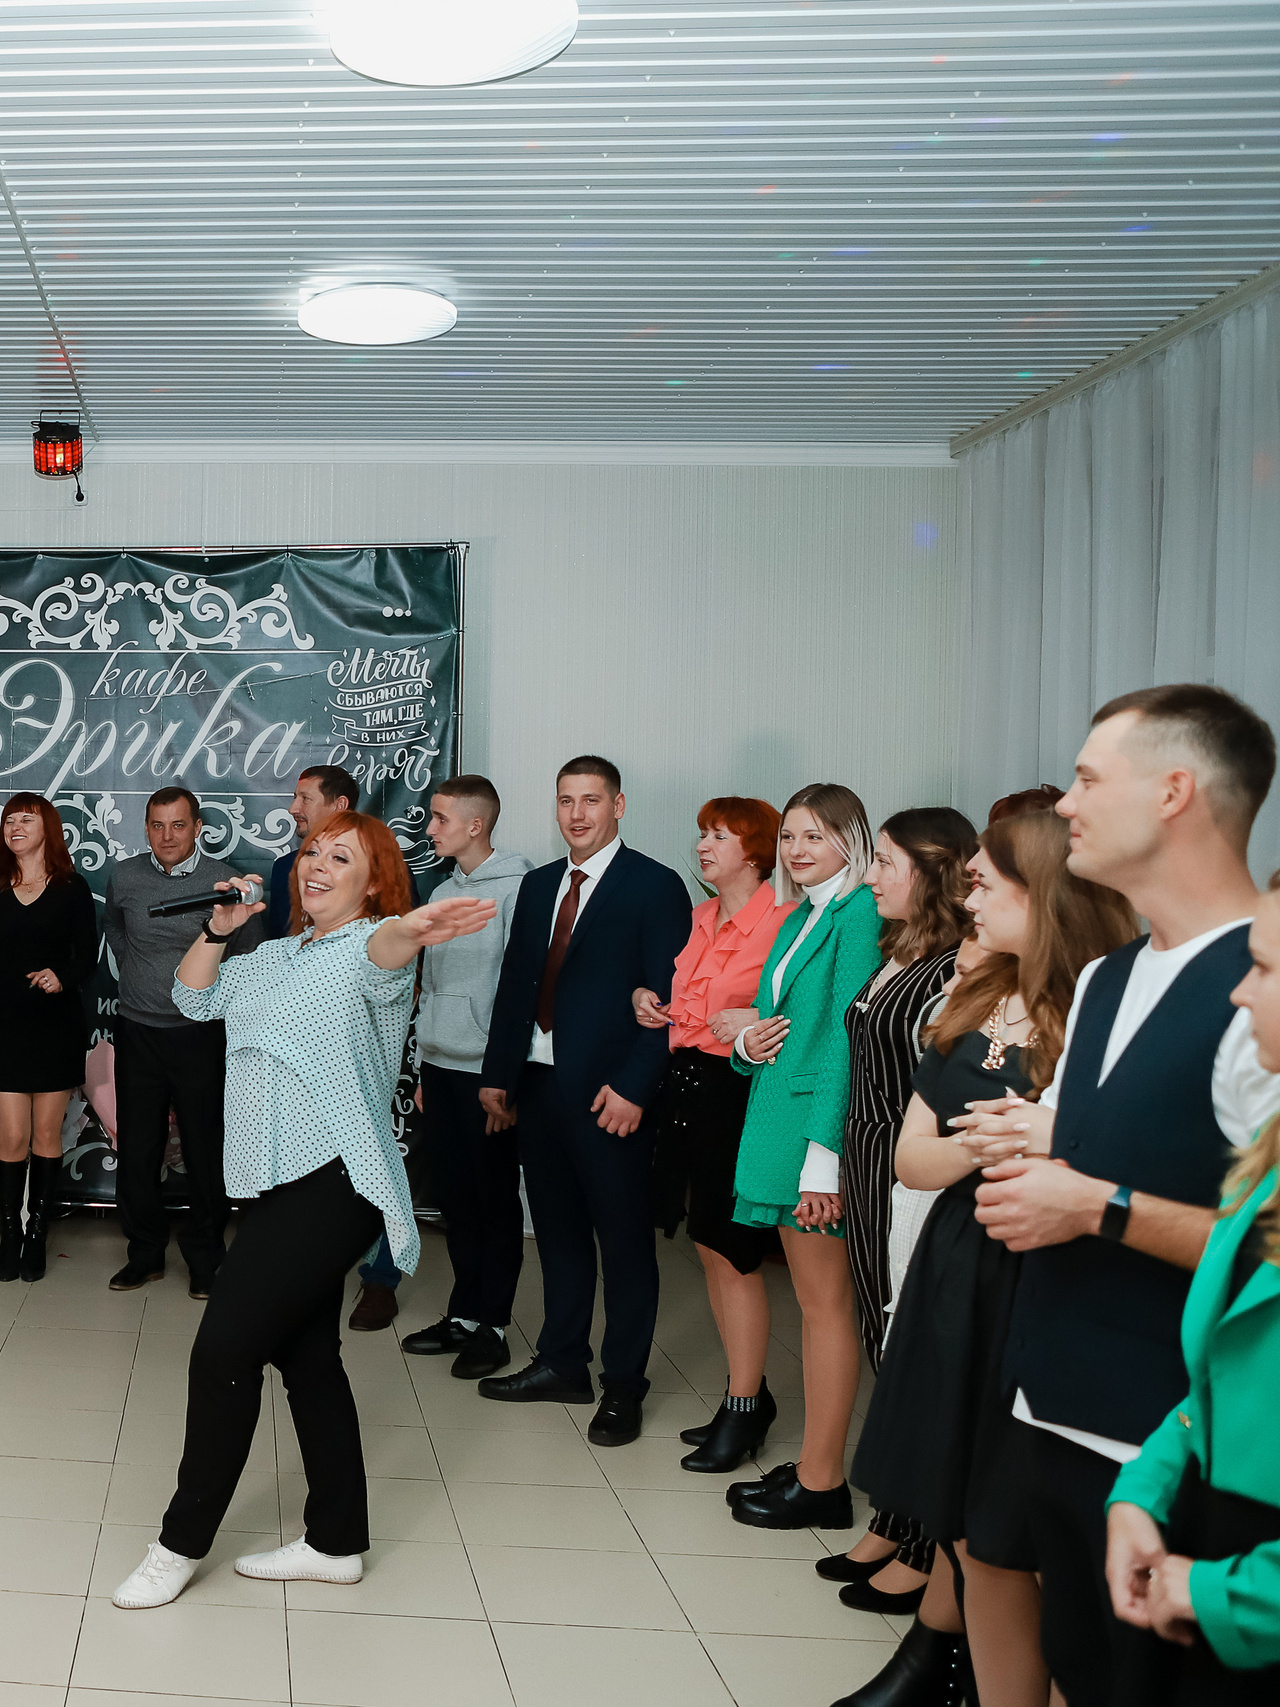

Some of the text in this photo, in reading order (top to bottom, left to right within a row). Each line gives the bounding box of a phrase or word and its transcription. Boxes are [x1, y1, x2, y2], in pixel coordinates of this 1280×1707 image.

[89, 641, 208, 714] кафе
[327, 648, 432, 687] Мечты
[337, 683, 423, 706] СБЫВАЮТСЯ
